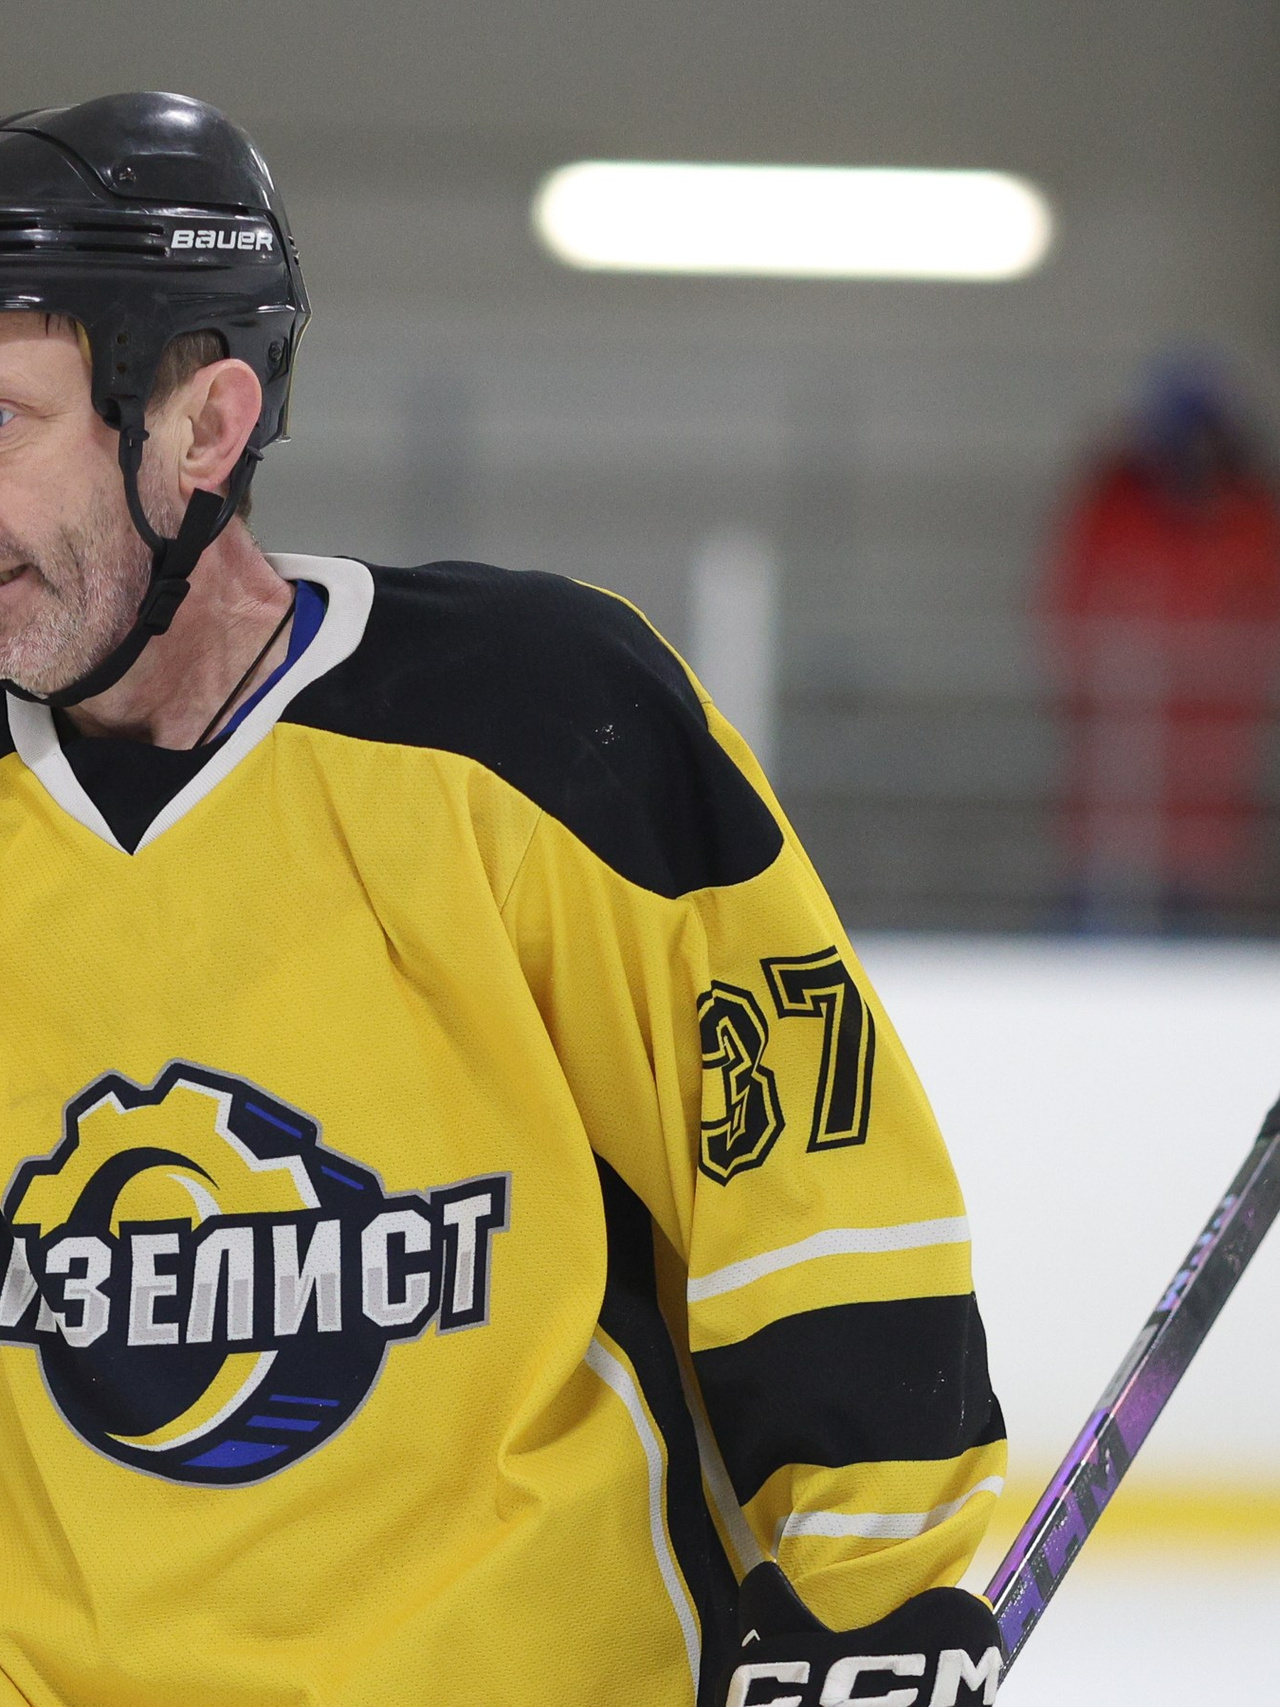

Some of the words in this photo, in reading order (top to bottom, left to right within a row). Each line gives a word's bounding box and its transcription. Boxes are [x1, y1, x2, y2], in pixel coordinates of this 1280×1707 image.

[170, 228, 275, 251] BAUER
[696, 944, 876, 1187] 37
[724, 1645, 1003, 1707] CCM
